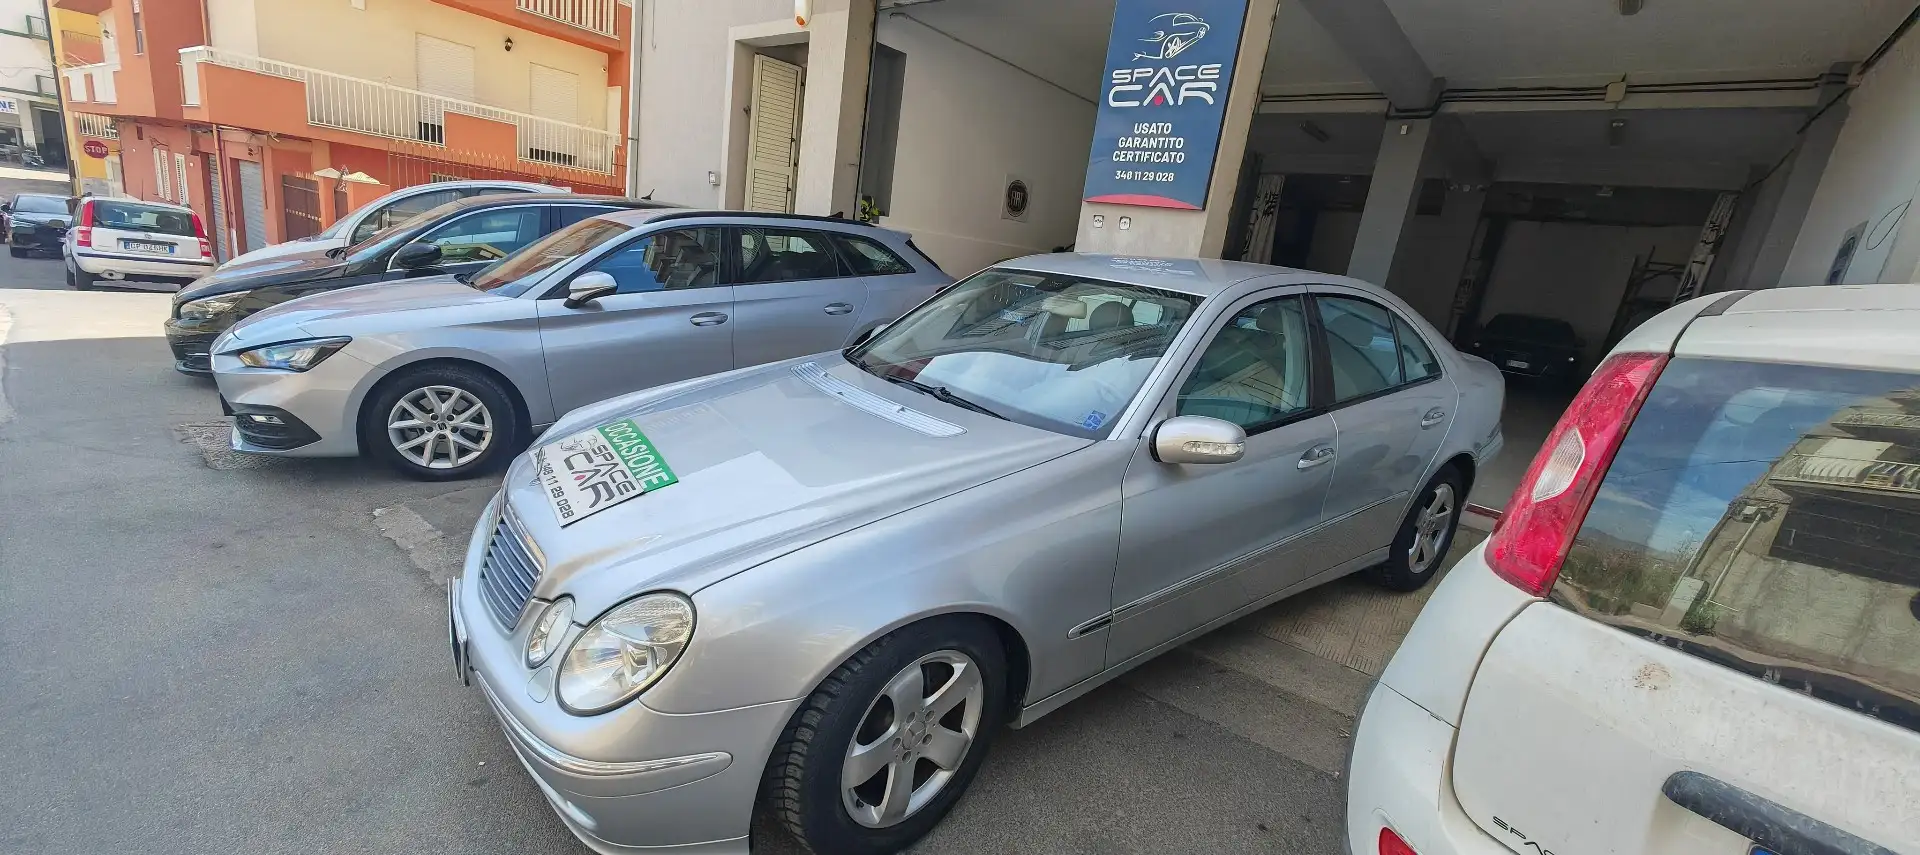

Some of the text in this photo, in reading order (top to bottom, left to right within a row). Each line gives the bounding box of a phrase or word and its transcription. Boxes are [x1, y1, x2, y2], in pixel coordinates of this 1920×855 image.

[1111, 63, 1222, 88] SPACE
[1108, 81, 1217, 107] CAR
[1134, 122, 1172, 134] USATO
[85, 145, 107, 154] STOP
[1118, 137, 1184, 149] GARANTITO
[1112, 151, 1185, 163] CERTIFICATO
[1134, 171, 1142, 180] 11
[1143, 171, 1155, 181] 29
[1156, 172, 1174, 182] 028
[604, 422, 670, 489] OCCASIONE
[591, 444, 637, 496] SPACE
[545, 475, 559, 486] 11
[563, 451, 616, 509] CAR
[550, 486, 565, 499] 29
[556, 498, 575, 519] 028
[1492, 815, 1555, 855] SPA
